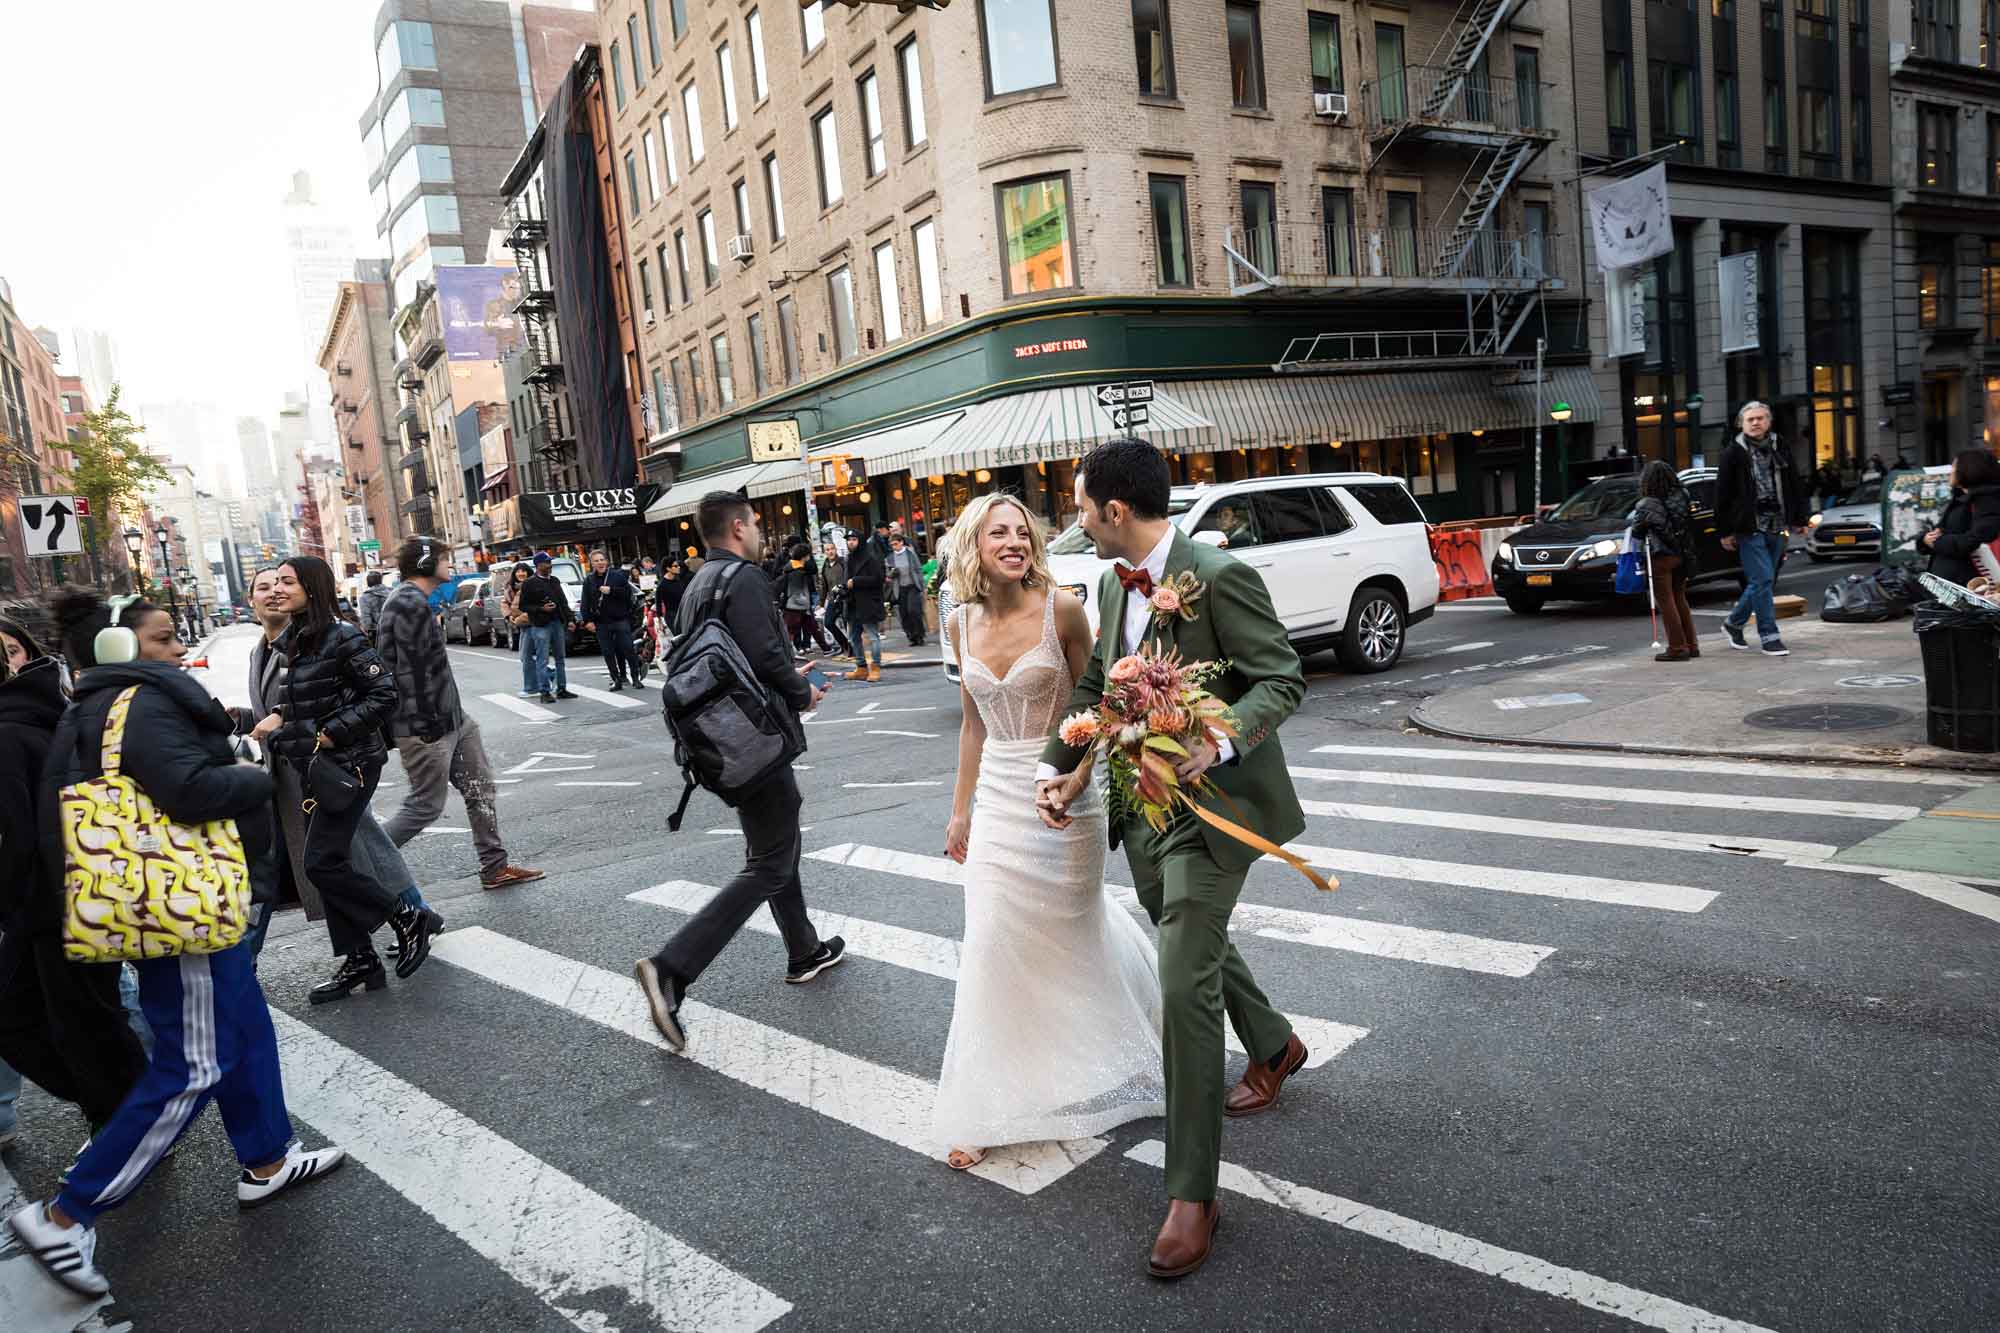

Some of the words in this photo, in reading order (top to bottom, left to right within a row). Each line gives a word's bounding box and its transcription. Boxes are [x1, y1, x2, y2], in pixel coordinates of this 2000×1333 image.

[1015, 344, 1040, 357] JACK'S
[1041, 341, 1061, 352] WIFE
[1063, 339, 1088, 350] FREDA
[1104, 390, 1121, 400] ONE
[1131, 388, 1147, 396] WAY
[994, 447, 1031, 463] JACK'S
[1064, 440, 1094, 456] FRE
[547, 488, 635, 510] LUCKYS
